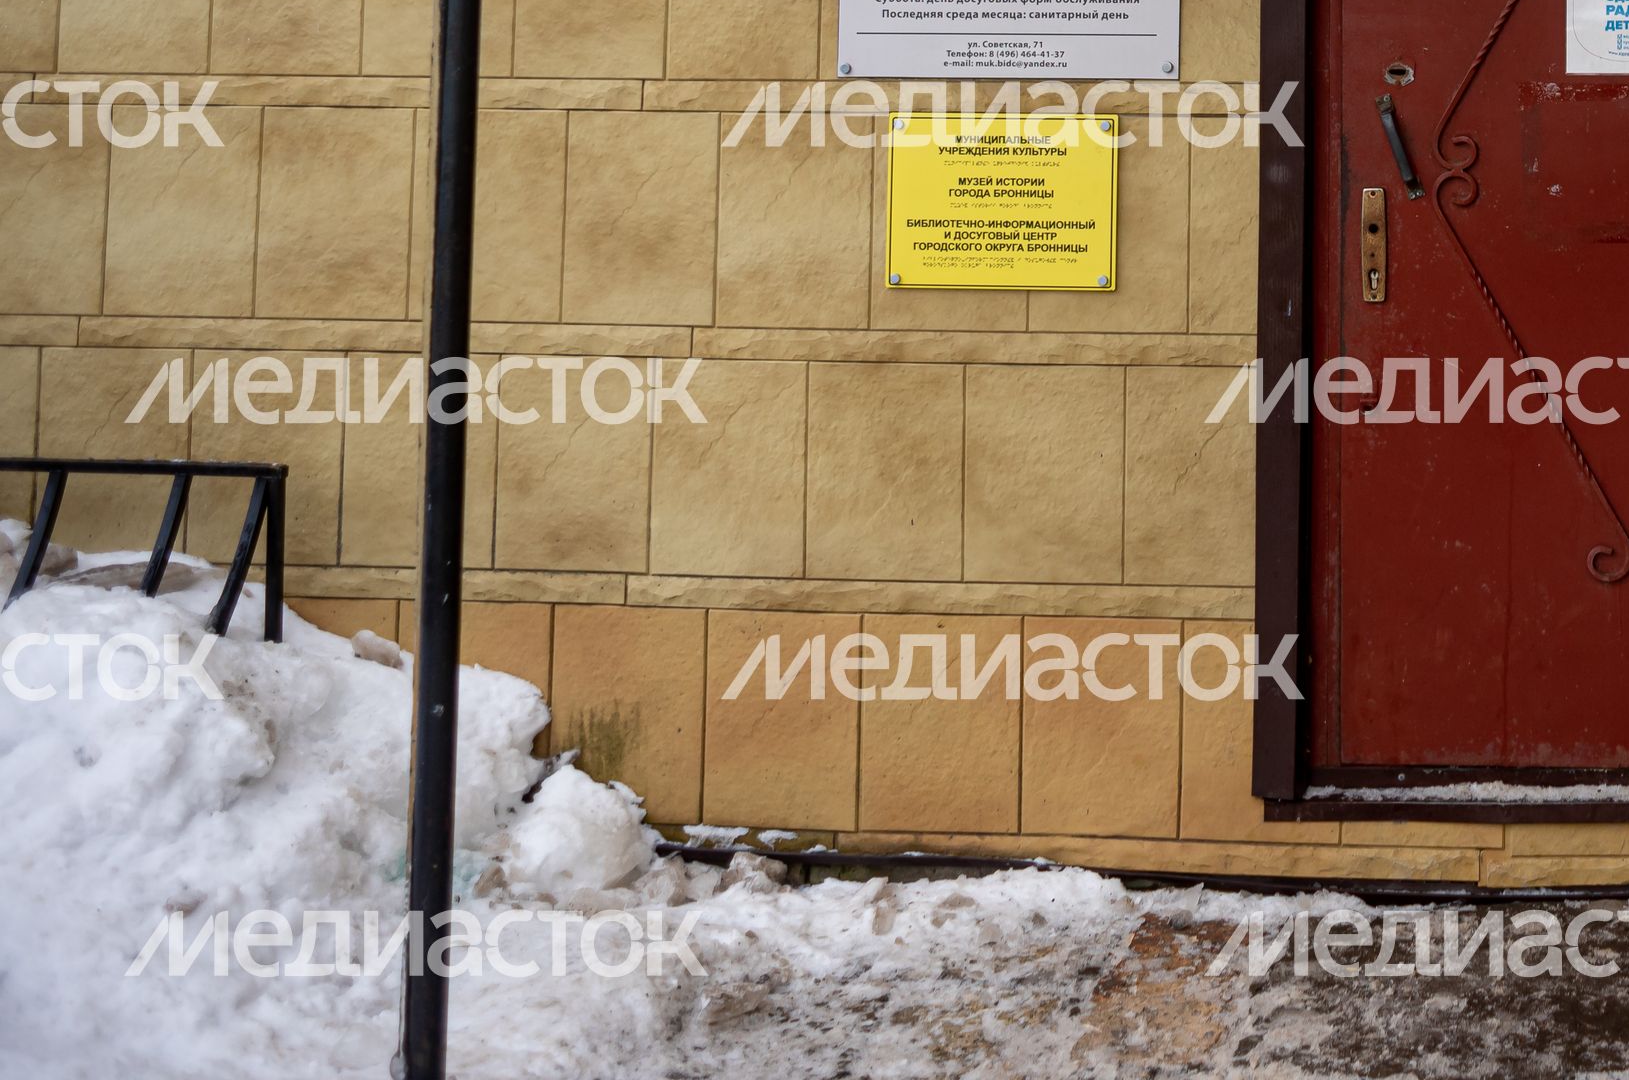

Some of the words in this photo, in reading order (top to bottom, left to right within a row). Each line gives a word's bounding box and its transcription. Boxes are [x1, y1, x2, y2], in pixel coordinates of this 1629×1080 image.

[882, 9, 943, 20] Последняя
[946, 12, 979, 20] среда
[982, 12, 1026, 20] месяца:
[1029, 10, 1098, 19] санитарный
[1101, 13, 1128, 21] день
[983, 41, 1031, 49] Советская,
[947, 50, 987, 59] Телефон:
[997, 50, 1018, 59] (496)
[1021, 50, 1064, 58] 464-41-37
[944, 60, 973, 68] e-mail:
[976, 60, 1067, 70] muk.bidc@yandex.ru
[955, 135, 1051, 146] МУНИЦИПАЛЬНЫЕ
[939, 146, 1010, 156] УЧРЕЖДЕНИЯ
[1013, 147, 1067, 156] КУЛЬТУРЫ
[959, 176, 993, 186] МУЗЕЙ
[996, 178, 1045, 186] ИСТОРИИ
[949, 189, 991, 198] ГОРОДА
[994, 189, 1054, 199] БРОННИЦЫ
[907, 219, 1095, 230] БИБЛИОТЕЧНО-ИНФОРМАЦИОННЫЙ
[954, 230, 1019, 240] ДОСУГОВЫЙ
[1023, 232, 1057, 241] ЦЕНТР
[914, 243, 982, 251] ГОРОДСКОГО
[985, 243, 1024, 252] ОКРУГА
[1028, 244, 1087, 253] БРОННИЦЫ
